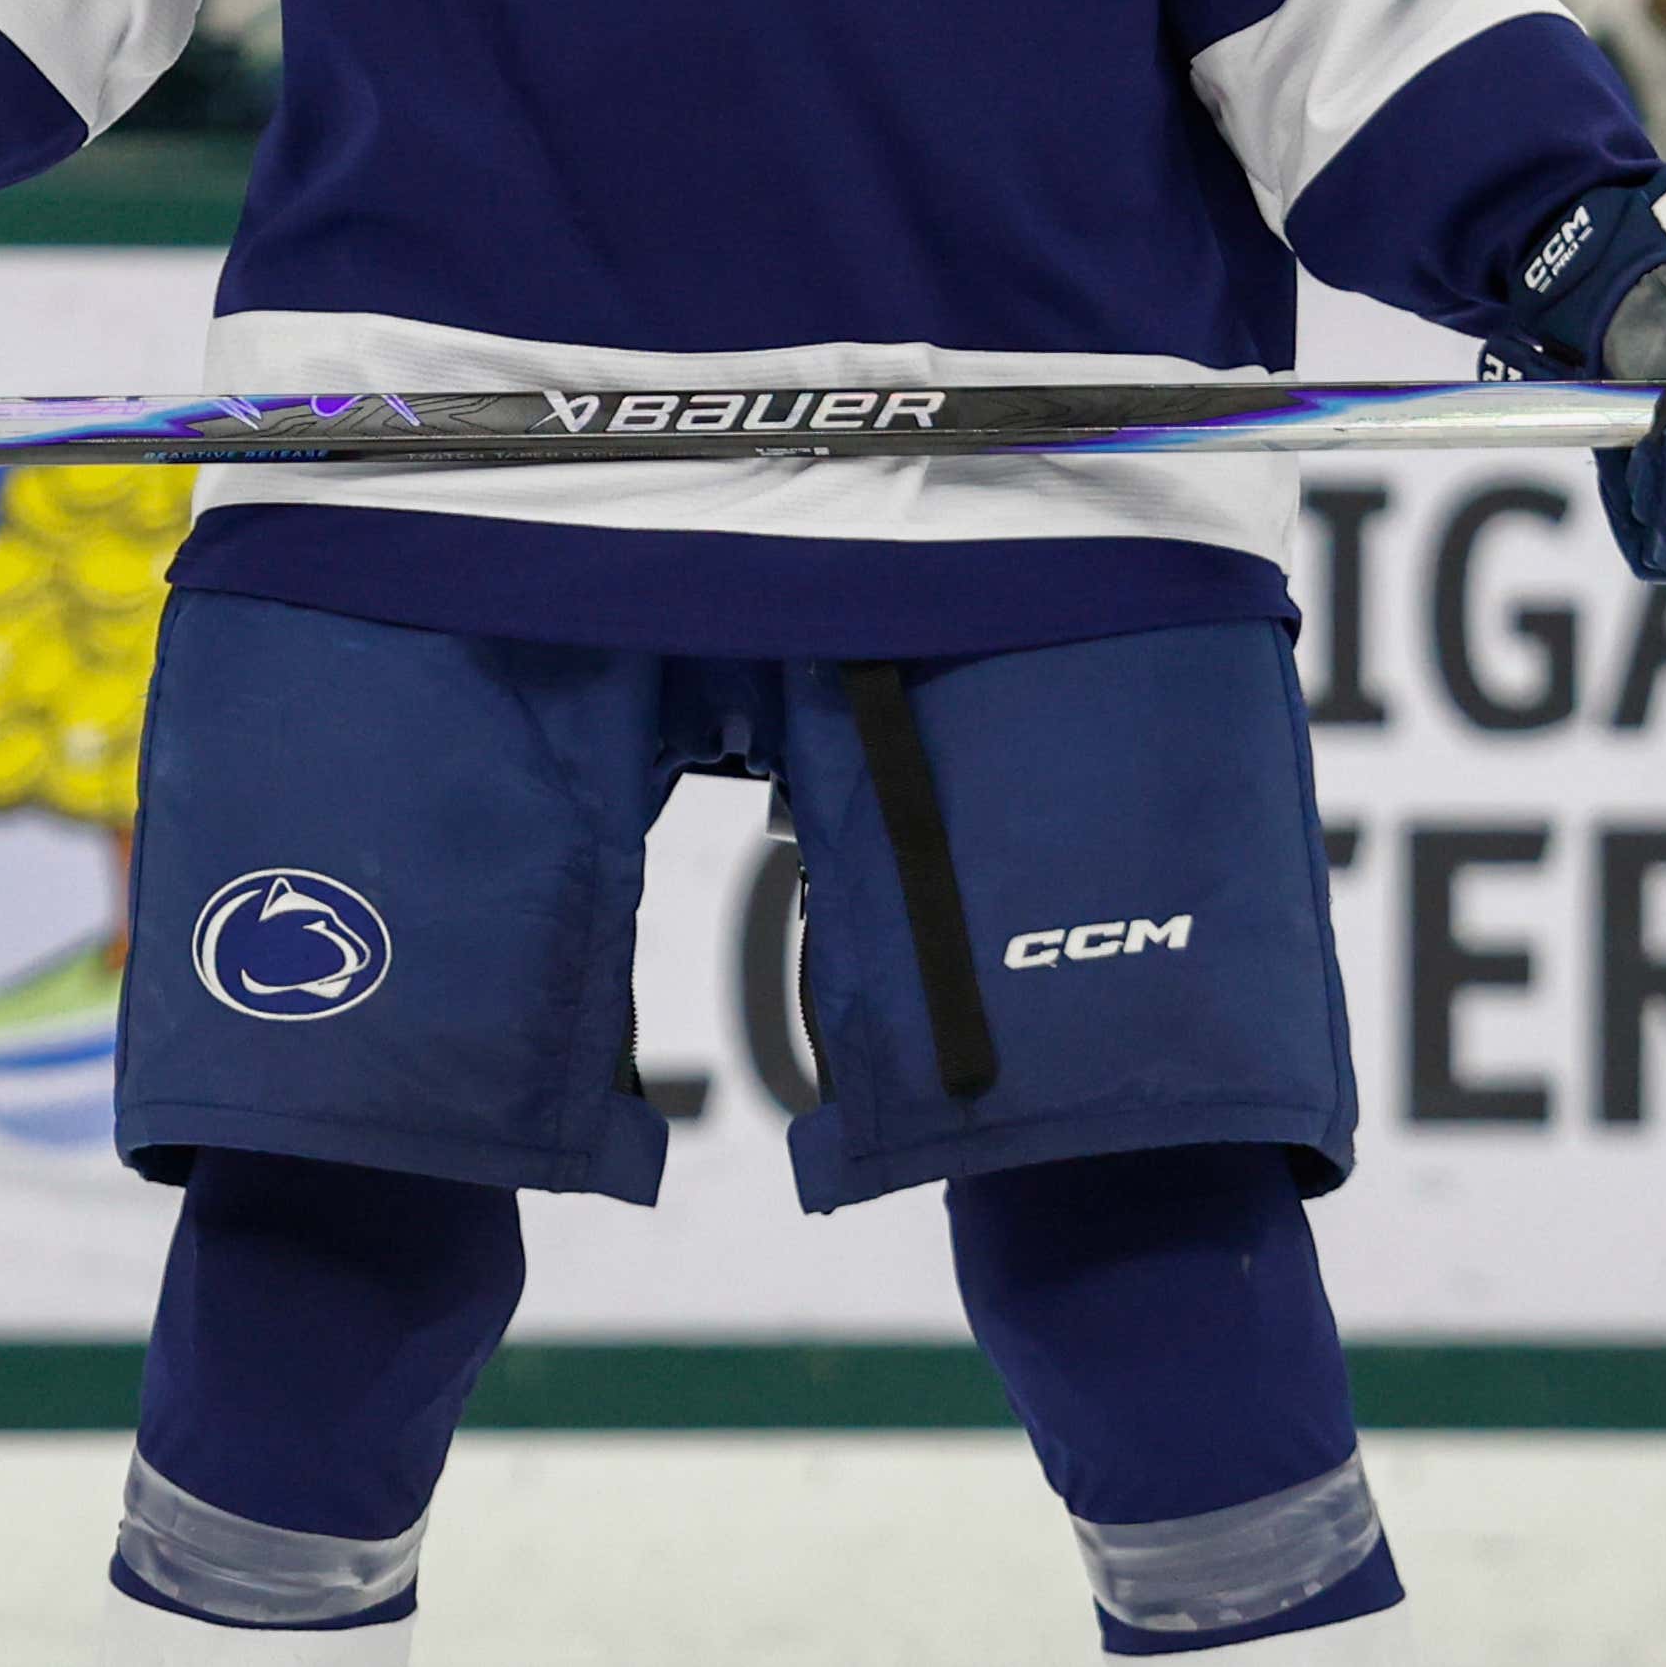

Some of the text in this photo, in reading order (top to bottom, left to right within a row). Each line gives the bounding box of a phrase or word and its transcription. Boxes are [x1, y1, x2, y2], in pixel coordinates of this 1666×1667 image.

[1524, 205, 1591, 289] CCM
[1551, 240, 1580, 276] PRO
[1003, 914, 1194, 971] CCM
